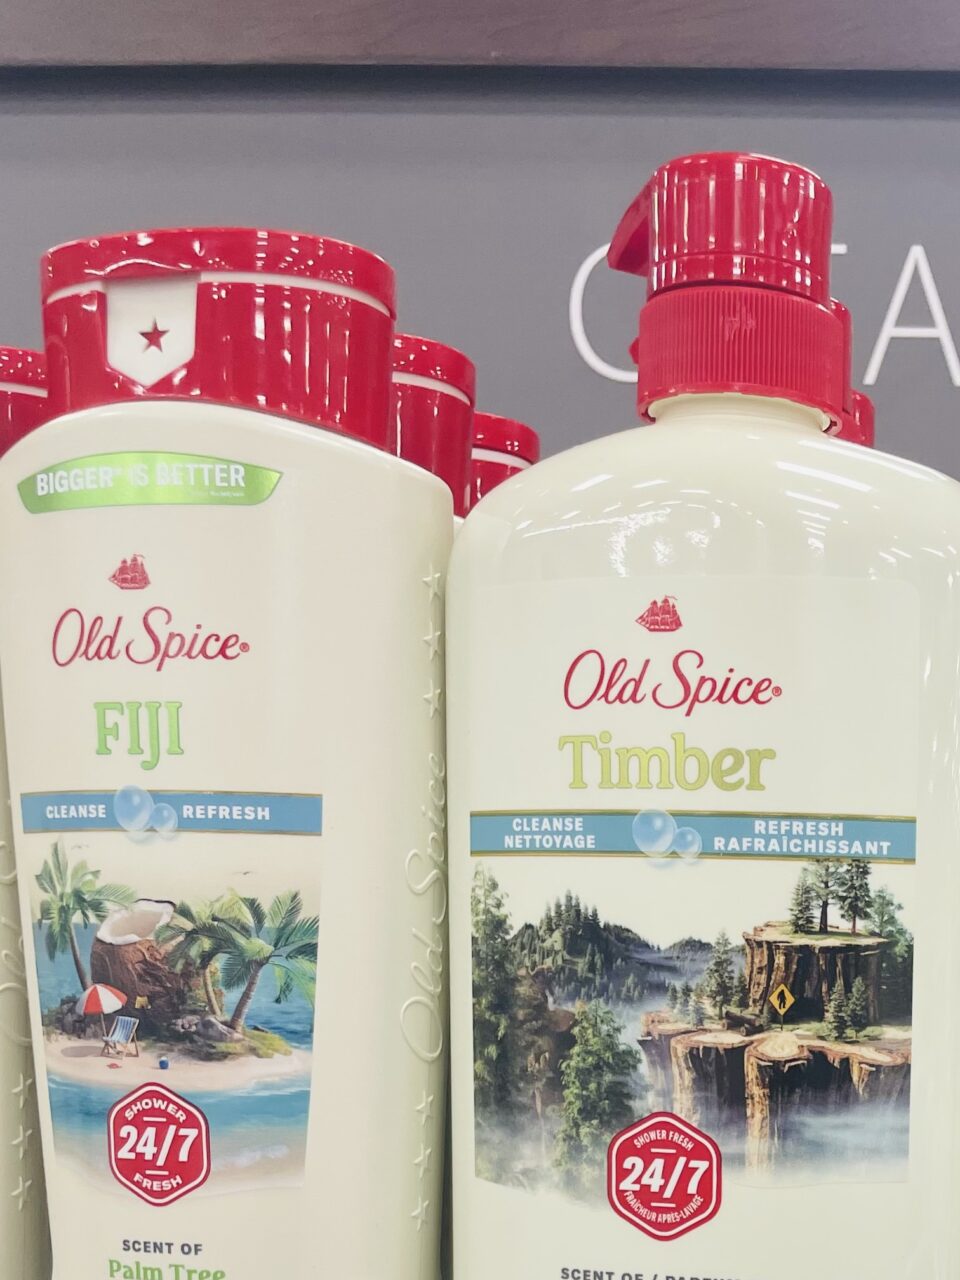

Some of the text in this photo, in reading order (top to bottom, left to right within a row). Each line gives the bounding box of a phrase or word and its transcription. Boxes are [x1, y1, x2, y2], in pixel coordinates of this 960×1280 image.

[128, 463, 149, 487] IS
[156, 462, 246, 488] BETTER
[51, 607, 123, 668] Old
[563, 649, 651, 710] Old
[93, 701, 184, 771] FIJI
[558, 731, 777, 791] Timber
[45, 804, 270, 821] CLEANSE REFRESH
[512, 817, 844, 837] CLEANSE REFRESH
[504, 834, 891, 856] NETTOYAGE RAFRAÎCHISSANT
[124, 1097, 187, 1123] SHOWER
[117, 1124, 199, 1166] 24/7
[633, 1130, 695, 1151] SHOWER FRESH
[133, 1174, 183, 1192] FRESH
[619, 1156, 710, 1199] 24/7
[121, 1239, 174, 1255] SCENT
